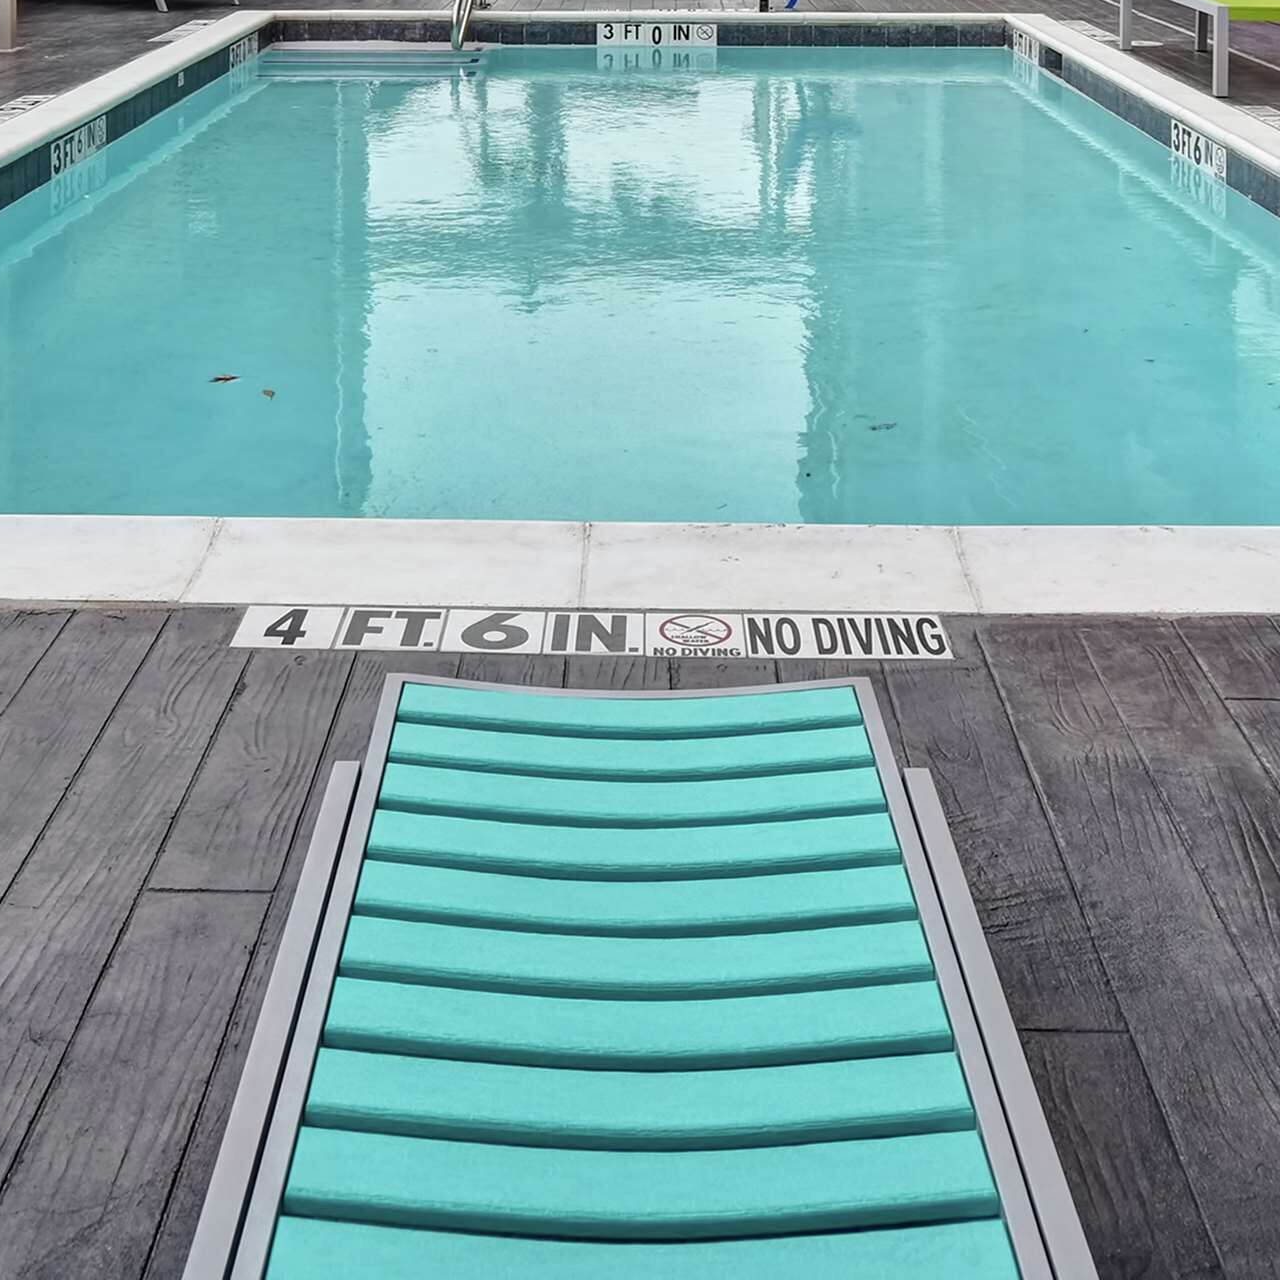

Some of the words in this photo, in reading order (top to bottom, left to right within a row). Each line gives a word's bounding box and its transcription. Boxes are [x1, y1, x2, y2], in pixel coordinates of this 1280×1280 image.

[603, 24, 614, 40] 3
[624, 24, 641, 40] FT
[673, 25, 690, 40] IN
[53, 142, 61, 175] 3
[1173, 122, 1181, 153] 3
[1194, 136, 1202, 166] 6
[263, 608, 309, 646] 4
[341, 609, 442, 648] FT.
[460, 612, 530, 651] 6
[550, 613, 640, 653] IN.
[746, 617, 802, 656] NO
[810, 617, 947, 656] DIVING
[652, 647, 677, 656] NO
[681, 647, 741, 657] DIVING
